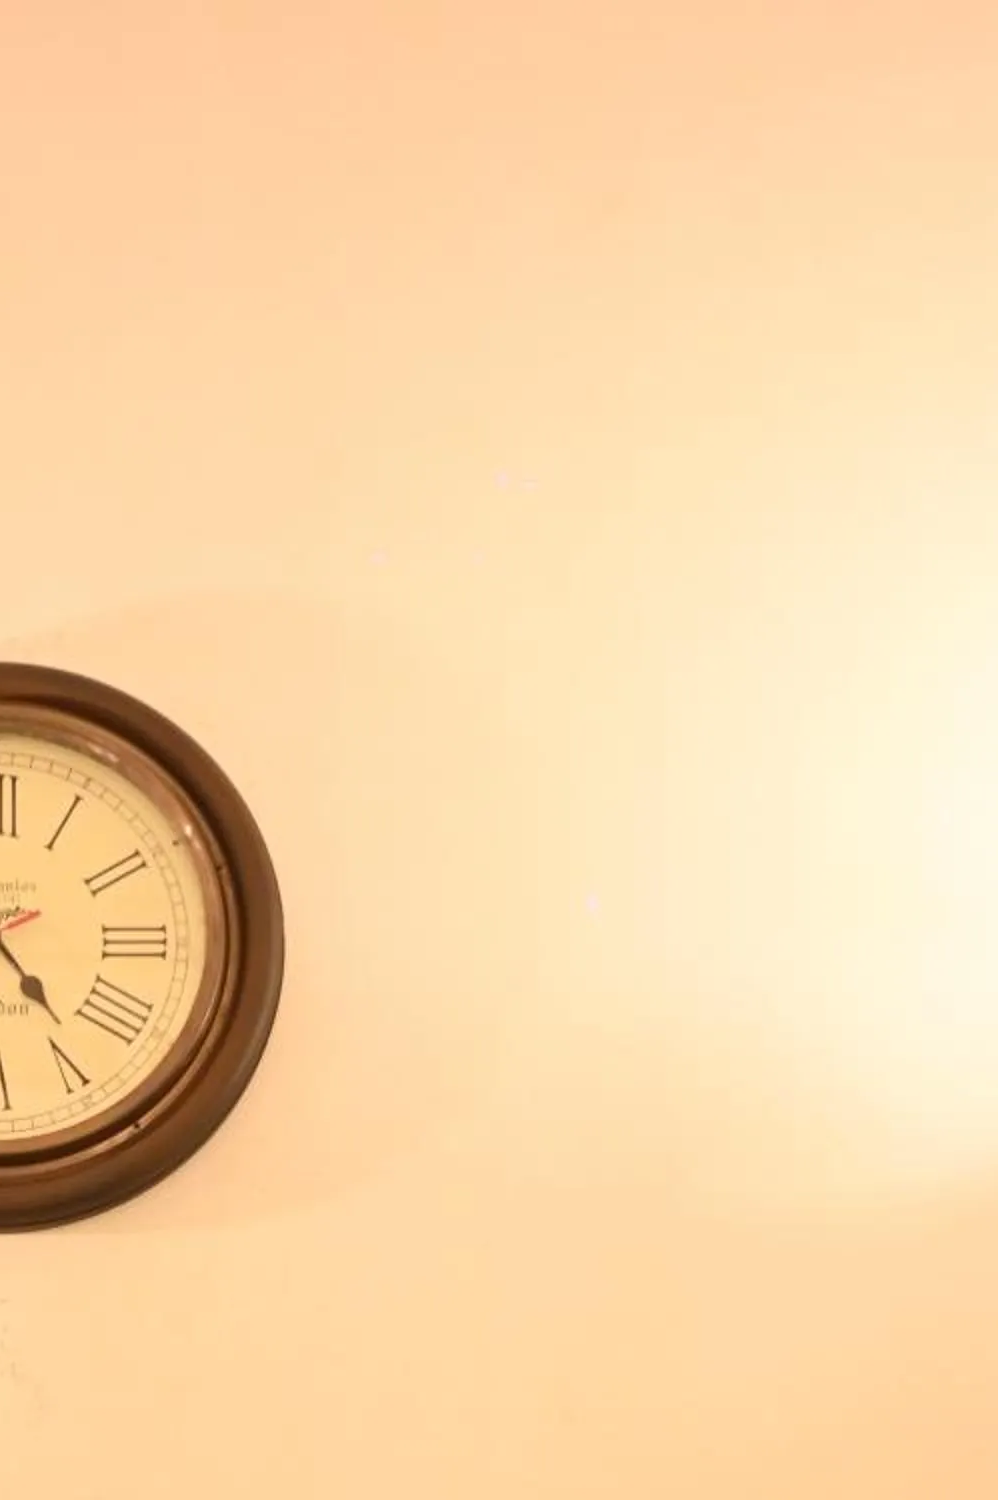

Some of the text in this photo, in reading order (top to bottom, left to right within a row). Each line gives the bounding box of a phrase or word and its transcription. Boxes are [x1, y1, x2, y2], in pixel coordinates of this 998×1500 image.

[44, 794, 83, 851] I
[84, 849, 147, 896] II
[101, 924, 167, 960] III
[48, 1036, 91, 1095] V
